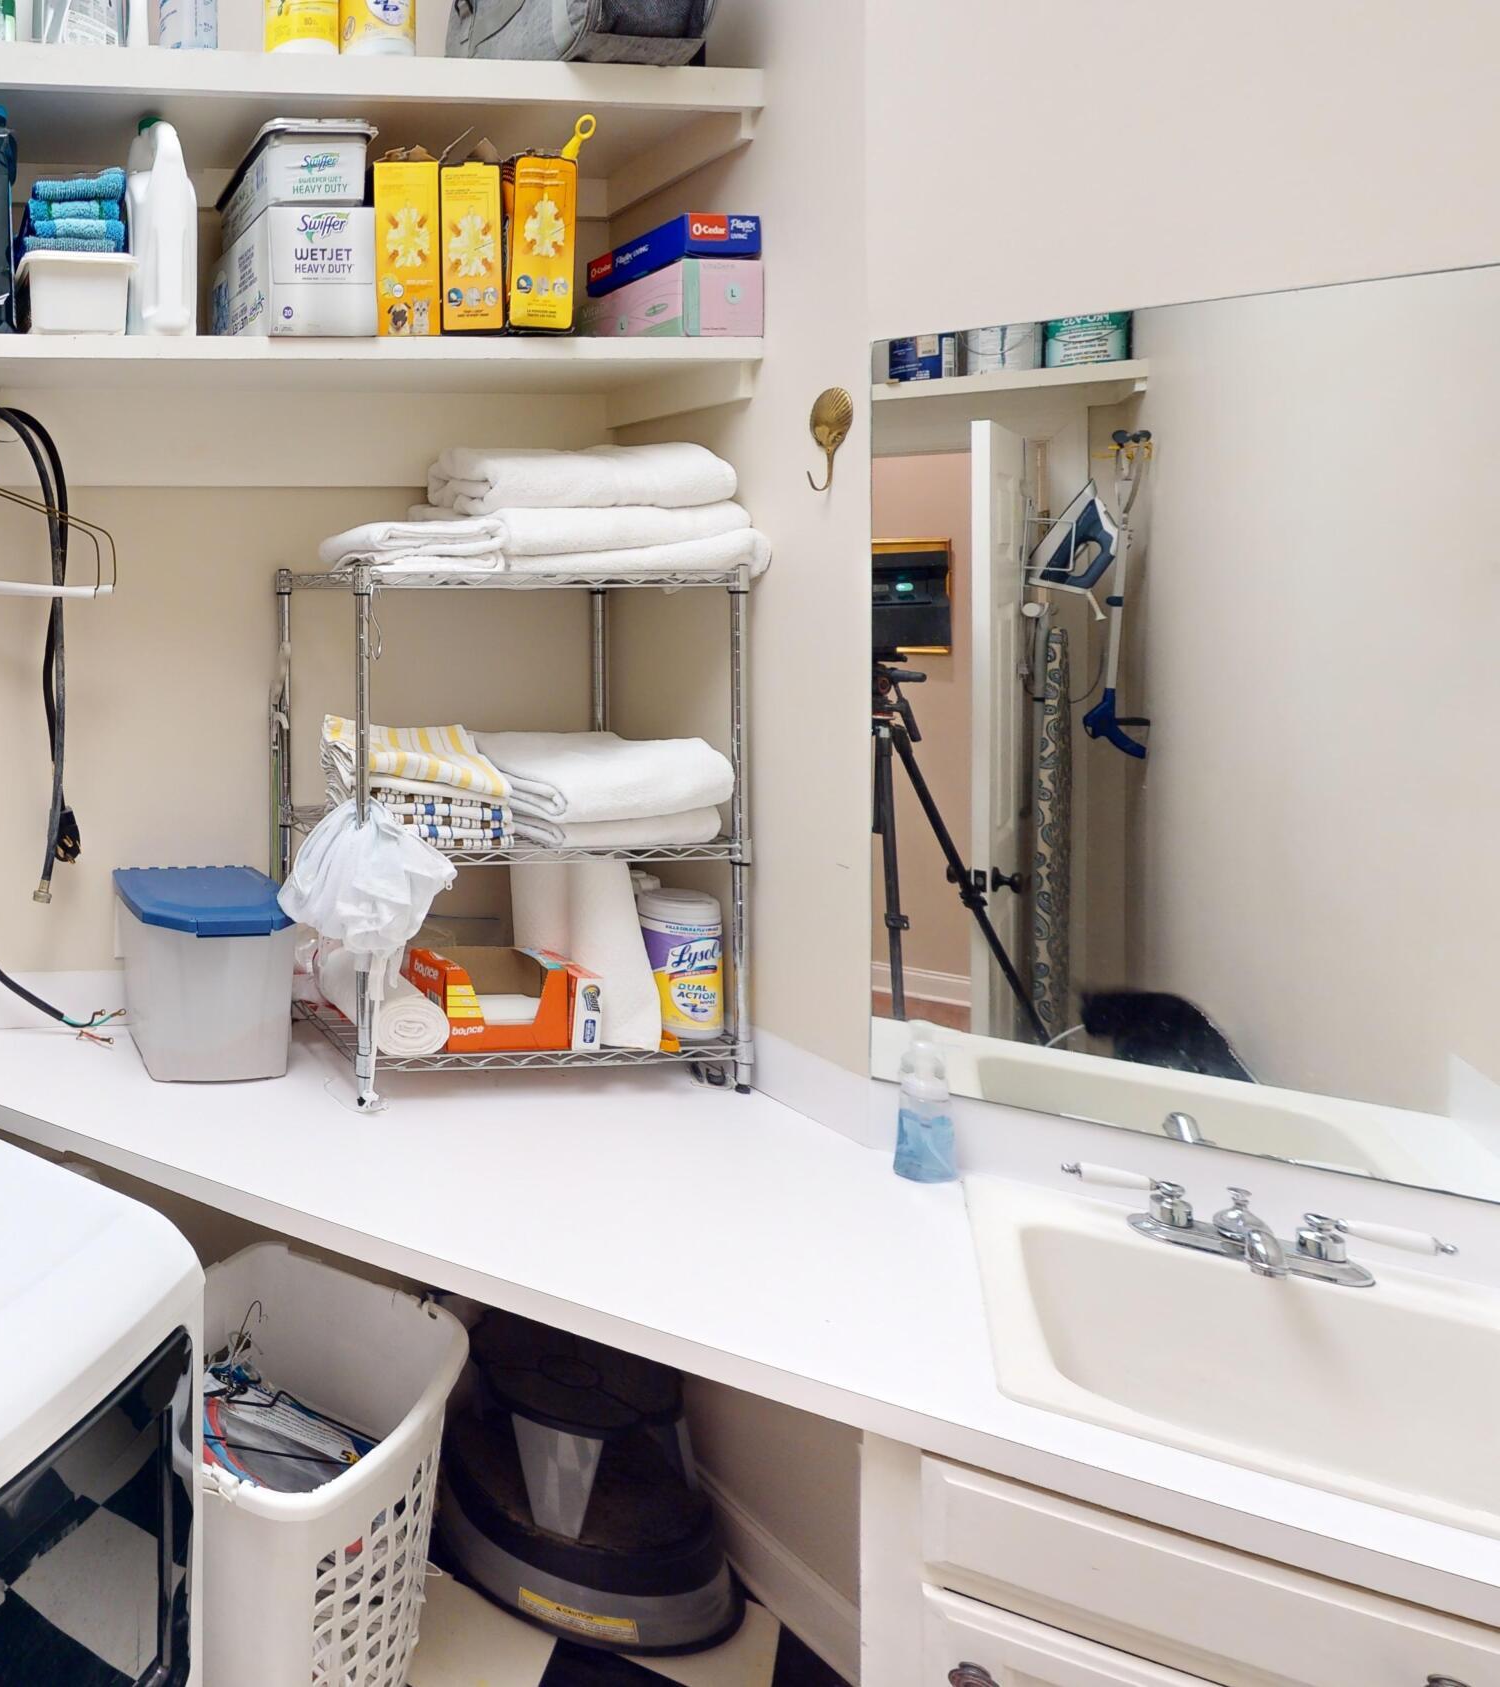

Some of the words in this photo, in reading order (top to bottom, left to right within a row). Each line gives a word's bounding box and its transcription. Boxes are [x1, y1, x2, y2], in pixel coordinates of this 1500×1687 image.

[301, 154, 338, 173] Swiffer
[292, 185, 322, 195] HEAVY
[324, 183, 348, 193] DUTY
[296, 214, 347, 237] Swiffer
[730, 218, 757, 233] Playtex
[294, 247, 353, 261] WETJET
[294, 263, 326, 274] HEAVY
[328, 263, 353, 273] DUTY
[731, 288, 738, 298] L
[284, 308, 292, 317] 20
[670, 941, 718, 970] Lysol
[414, 958, 440, 982] bounce
[678, 983, 708, 992] DUAL
[677, 991, 716, 1000] ACTION
[451, 1024, 485, 1037] bounce
